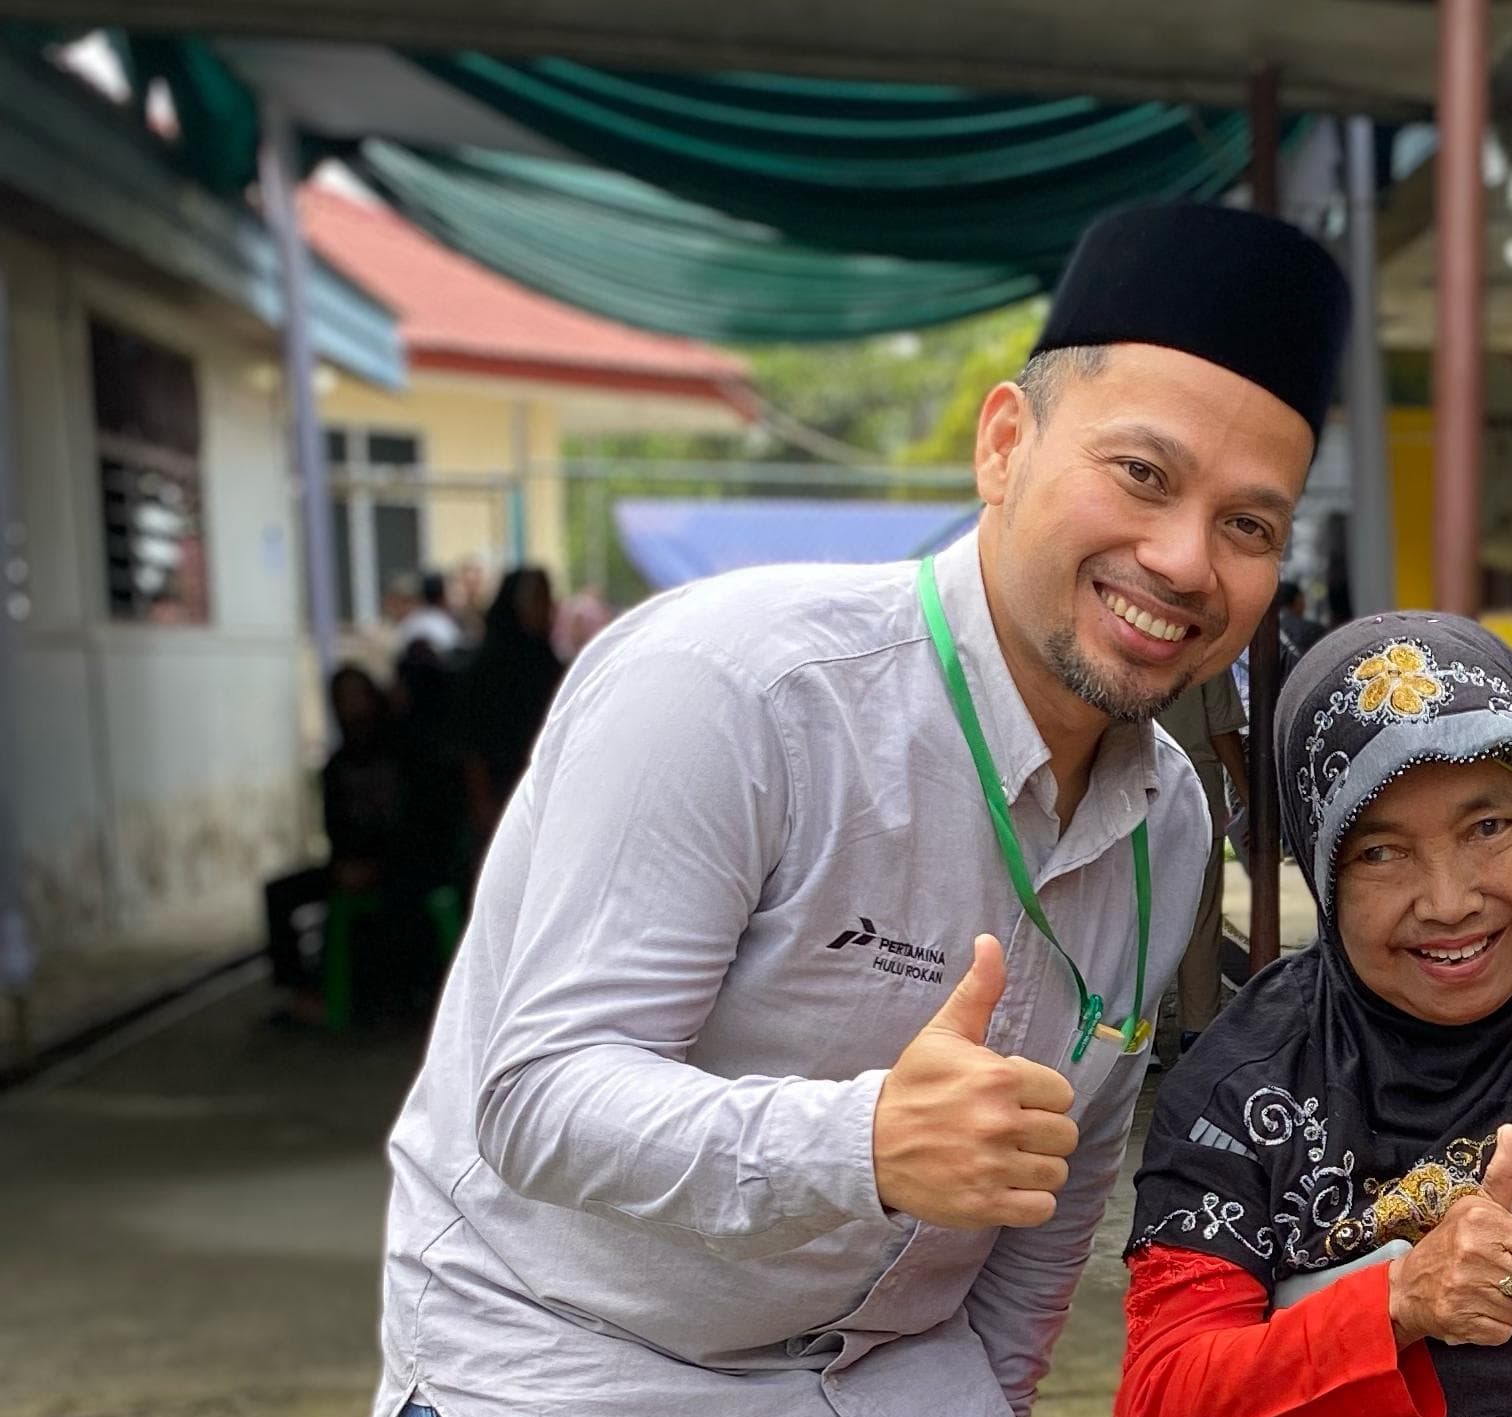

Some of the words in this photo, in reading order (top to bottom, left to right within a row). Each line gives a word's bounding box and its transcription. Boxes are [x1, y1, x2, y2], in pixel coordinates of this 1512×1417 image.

[879, 937, 946, 966] PERTAMINA
[873, 956, 904, 976] HULU
[905, 964, 944, 985] ROKAN
